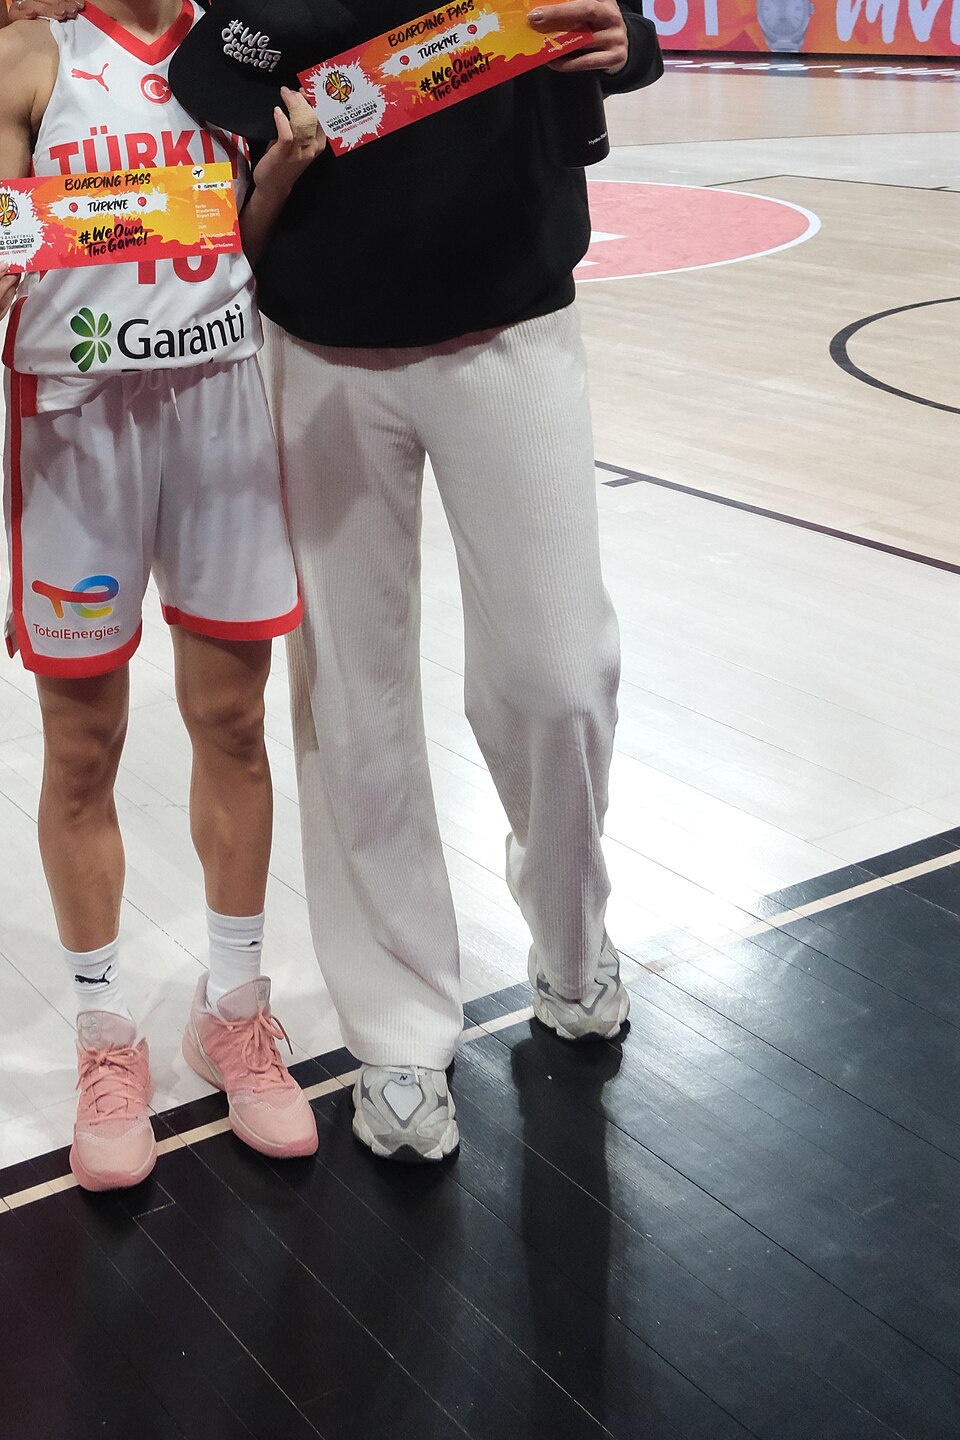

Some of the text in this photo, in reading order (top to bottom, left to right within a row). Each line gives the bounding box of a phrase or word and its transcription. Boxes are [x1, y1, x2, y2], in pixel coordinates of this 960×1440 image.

[229, 19, 270, 48] #We
[388, 0, 474, 47] BOARDING PASS
[223, 43, 278, 72] Game!
[327, 115, 350, 129] WORLD
[350, 110, 362, 119] CUP
[362, 103, 378, 113] 2026
[64, 172, 151, 191] BOARDING PASS
[116, 303, 245, 360] Garanti
[33, 623, 120, 641] TotalEnergies
